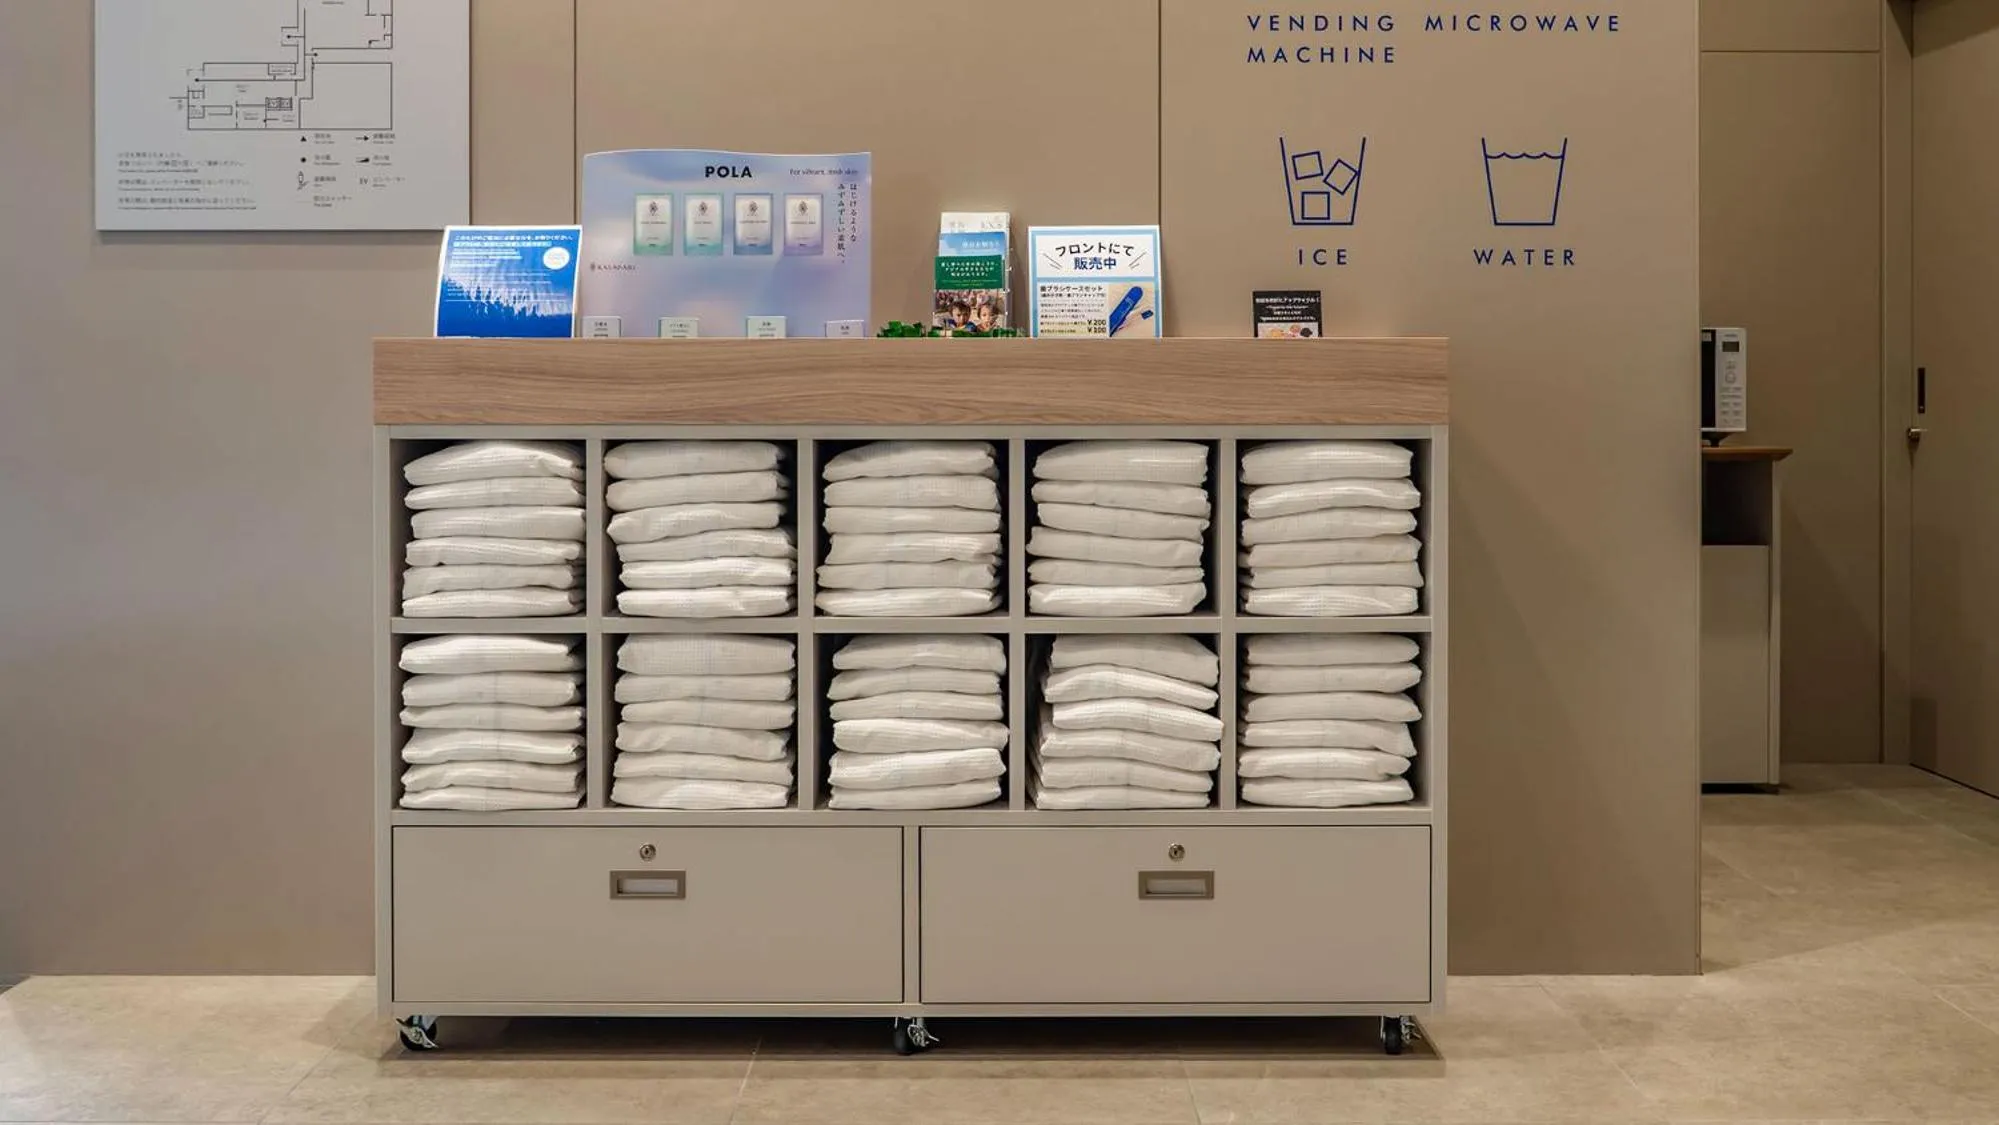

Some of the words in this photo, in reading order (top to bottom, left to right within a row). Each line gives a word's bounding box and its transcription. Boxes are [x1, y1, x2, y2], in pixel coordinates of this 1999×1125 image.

[1247, 15, 1394, 32] VENDING
[1425, 15, 1619, 32] MICROWAVE
[1247, 47, 1395, 63] MACHINE
[705, 166, 752, 178] POLA
[849, 183, 858, 243] はじけるような
[1055, 242, 1135, 257] フロントにて
[1298, 249, 1348, 266] ICE
[1474, 249, 1576, 266] WATER
[1074, 256, 1117, 270] 販売中
